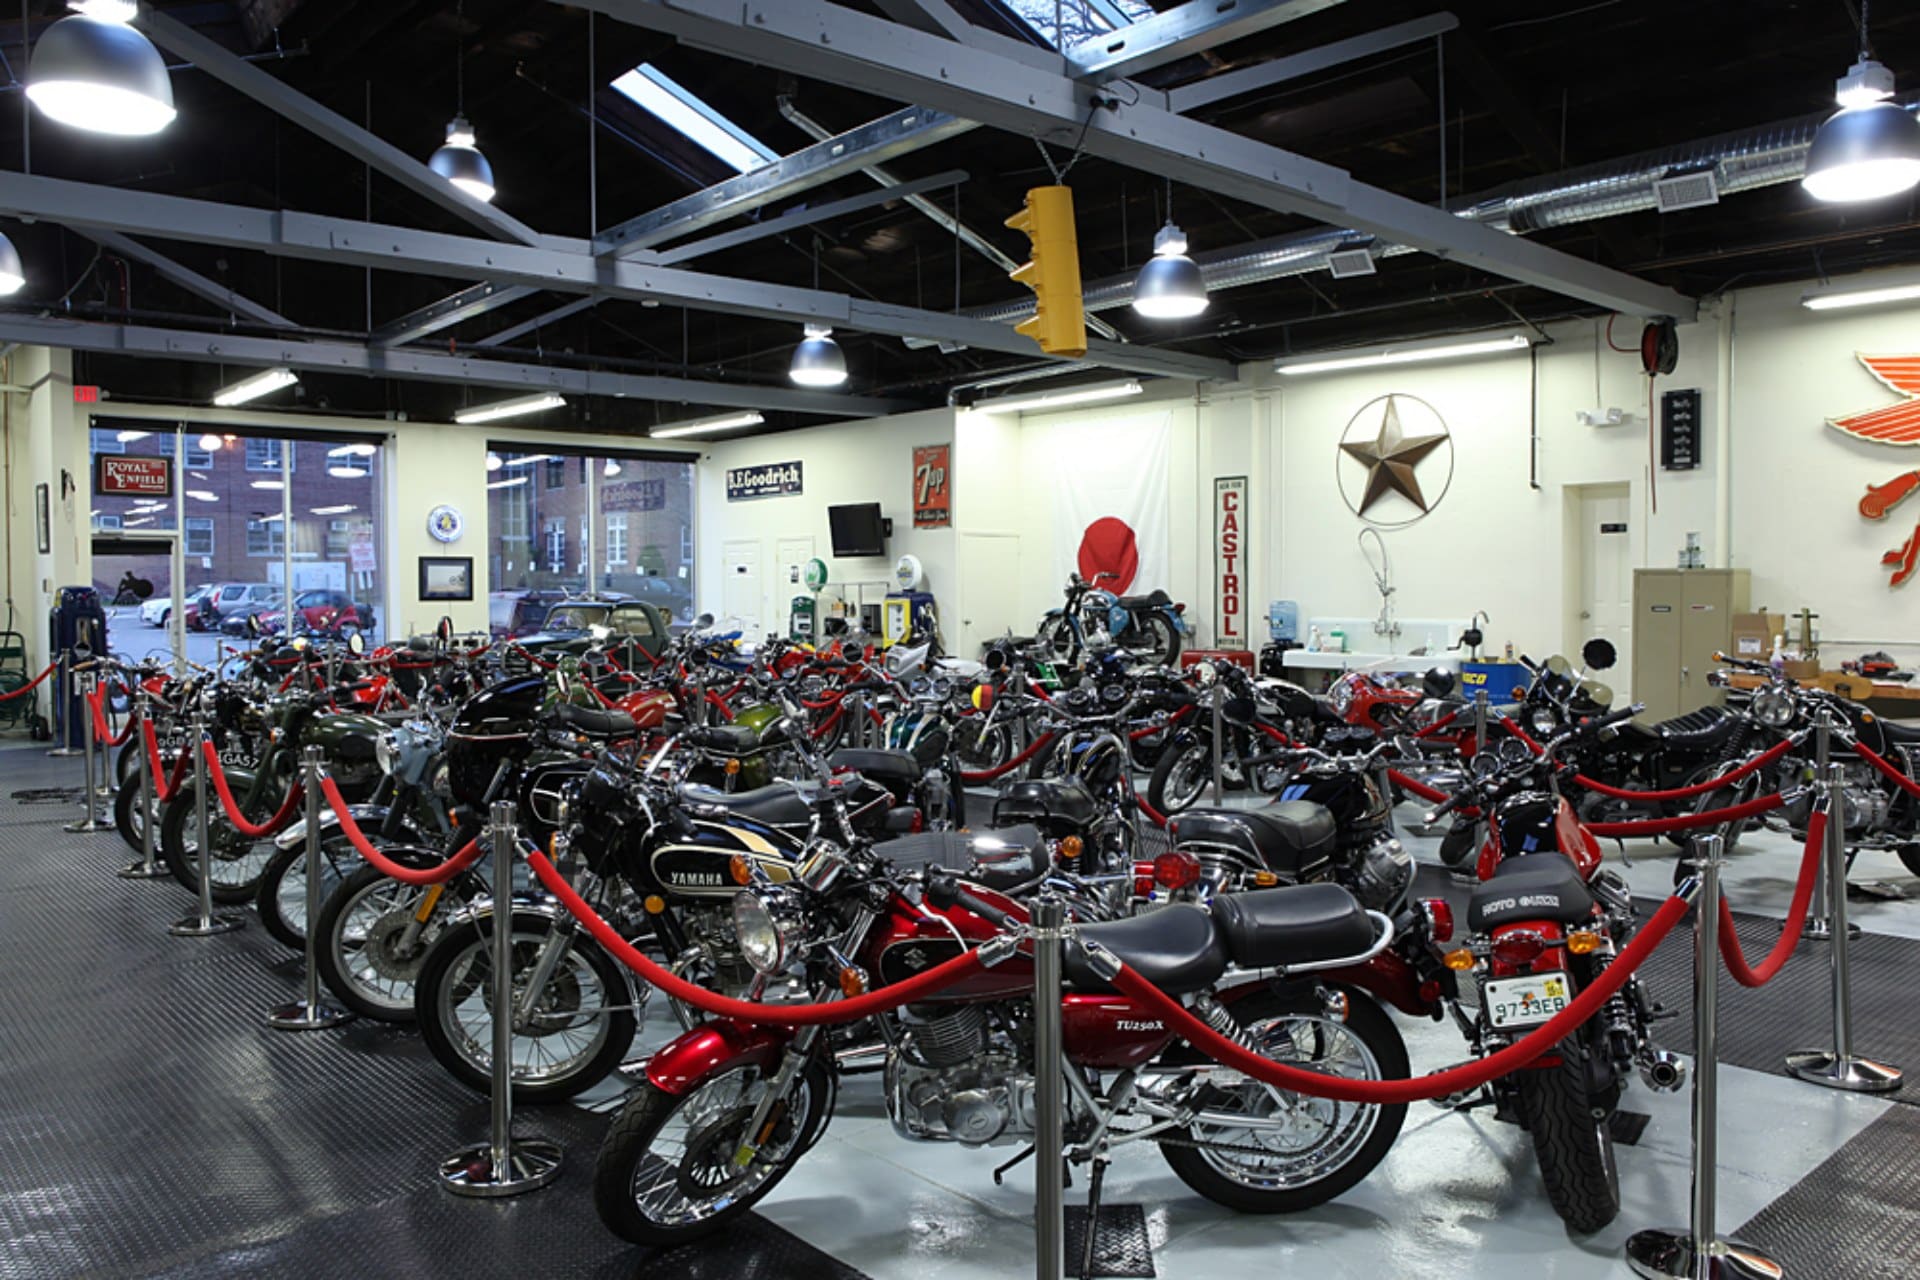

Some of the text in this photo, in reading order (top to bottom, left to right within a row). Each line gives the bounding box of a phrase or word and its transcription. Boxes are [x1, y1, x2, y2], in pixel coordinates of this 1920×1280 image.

[107, 462, 149, 477] ROYAL
[118, 474, 165, 488] ENFIELD
[1222, 491, 1239, 636] CASTROL
[671, 871, 723, 886] YAMAHA
[1482, 895, 1560, 917] MOTO GUZZI
[1117, 1019, 1164, 1031] TU250X
